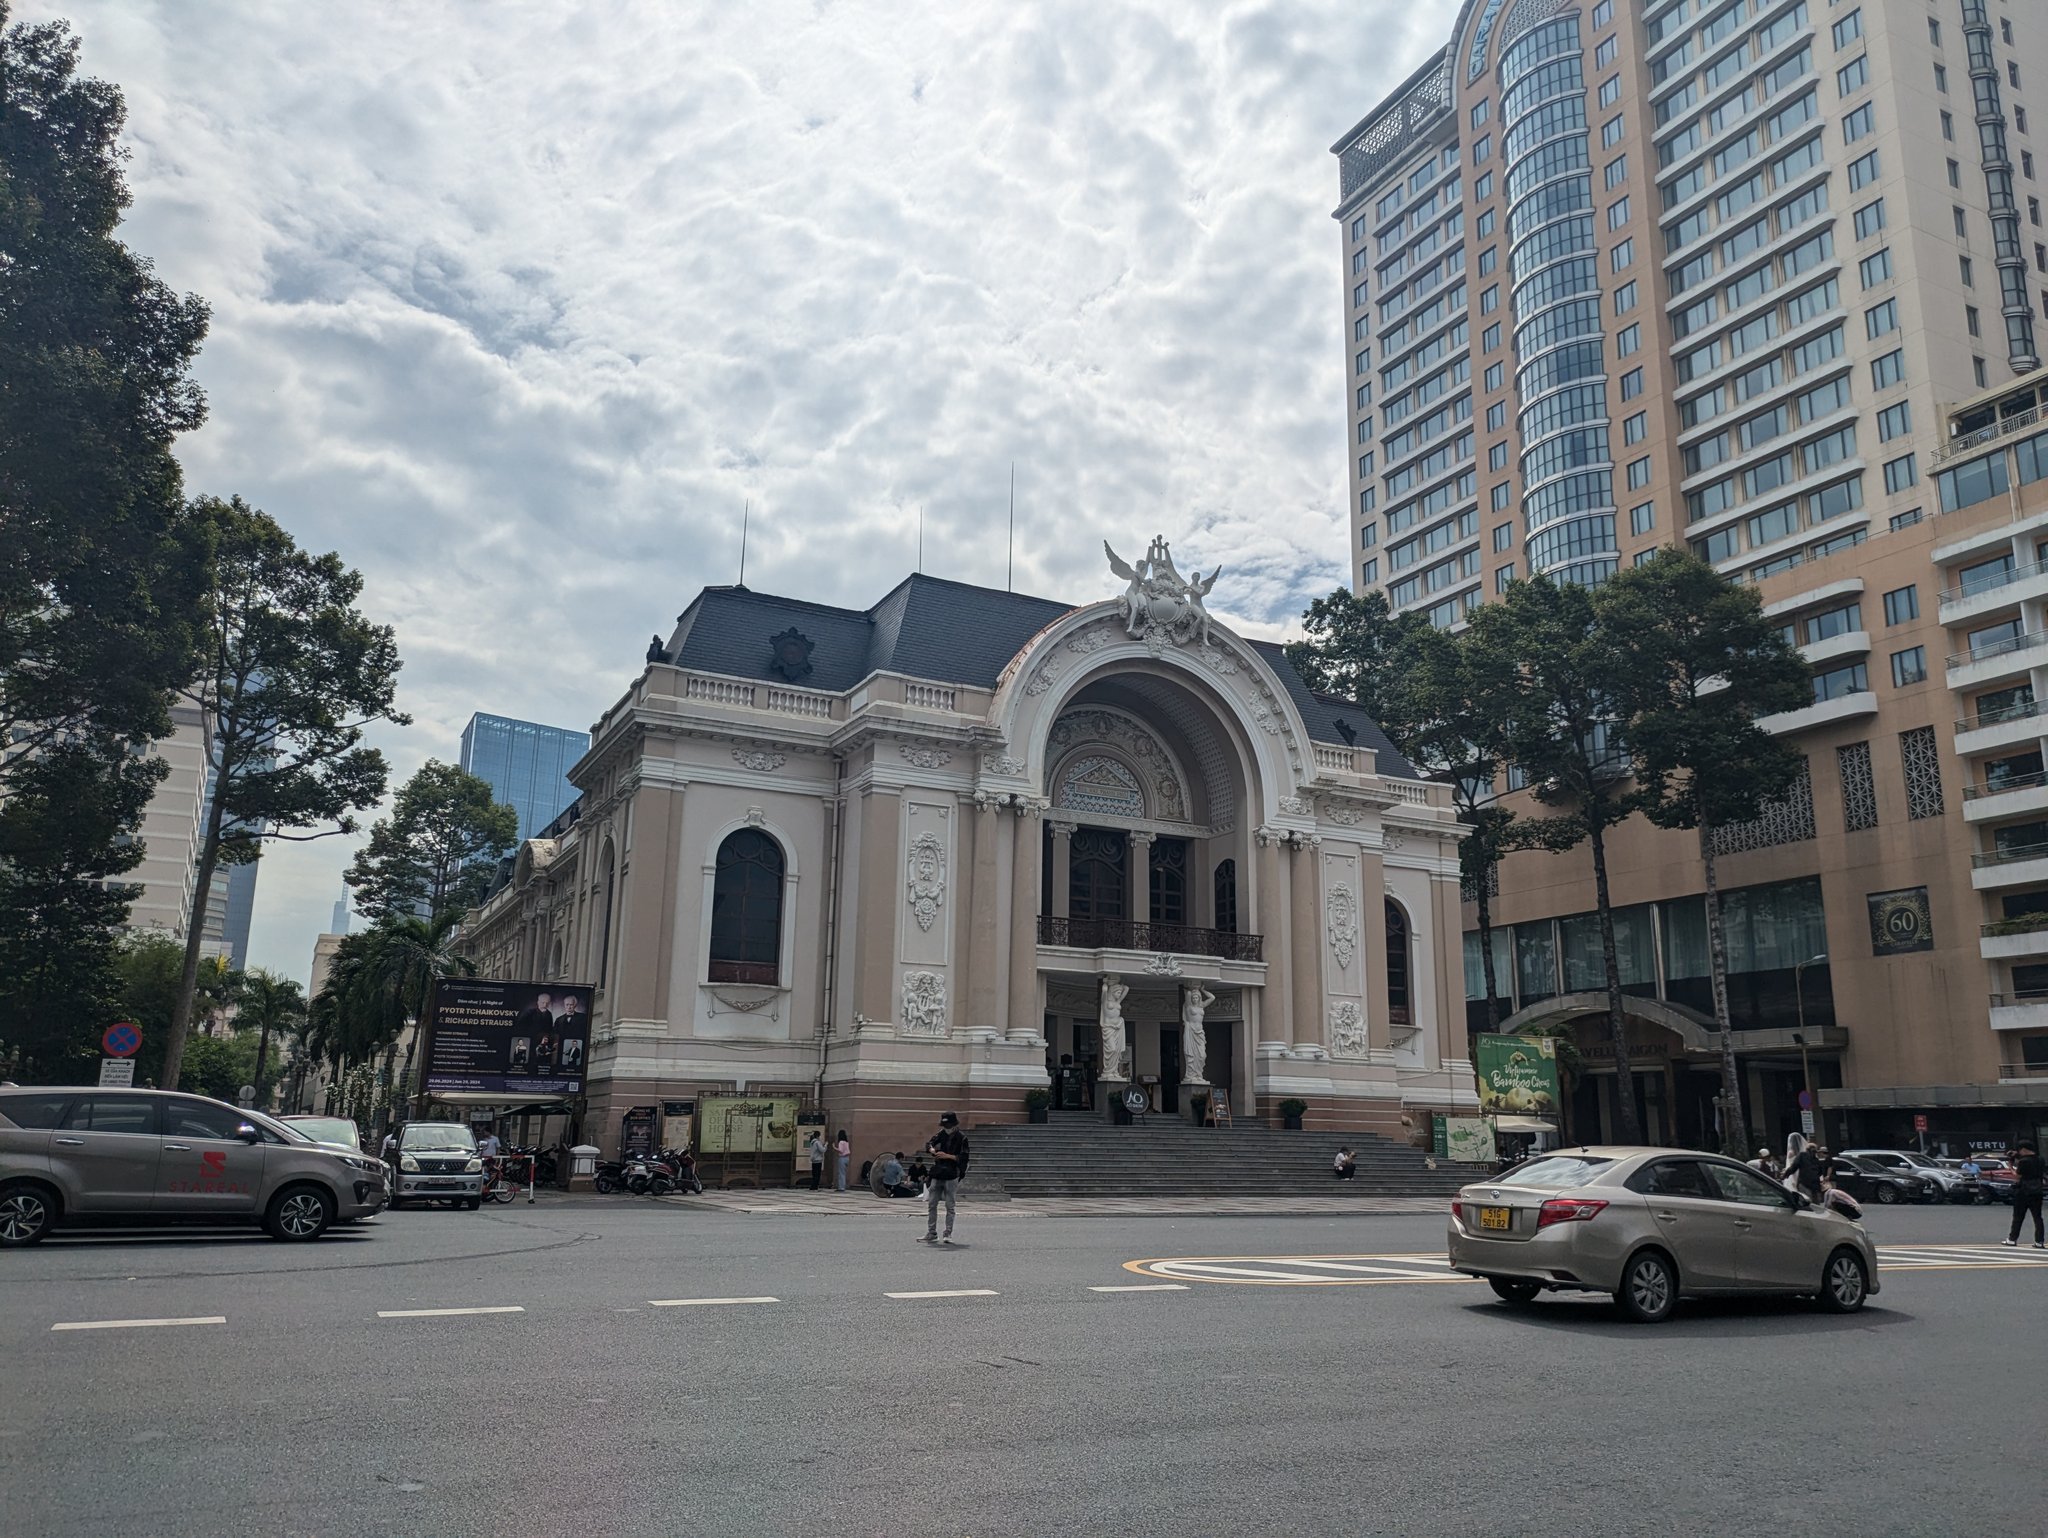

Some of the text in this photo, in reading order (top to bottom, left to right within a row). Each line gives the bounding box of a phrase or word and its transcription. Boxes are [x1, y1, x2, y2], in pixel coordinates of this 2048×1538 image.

[1890, 911, 1914, 932] 60
[466, 1008, 520, 1017] TCHAIKOVSKY
[445, 1017, 479, 1025] RICHARD
[480, 1018, 514, 1027] STRAUSS
[1490, 1070, 1551, 1089] Bamboo Circus
[709, 1116, 744, 1124] OPRA
[708, 1125, 743, 1133] HOSE
[1968, 1141, 2006, 1149] VERTU
[168, 1180, 249, 1194] STAREAL
[1488, 1209, 1501, 1218] 51G
